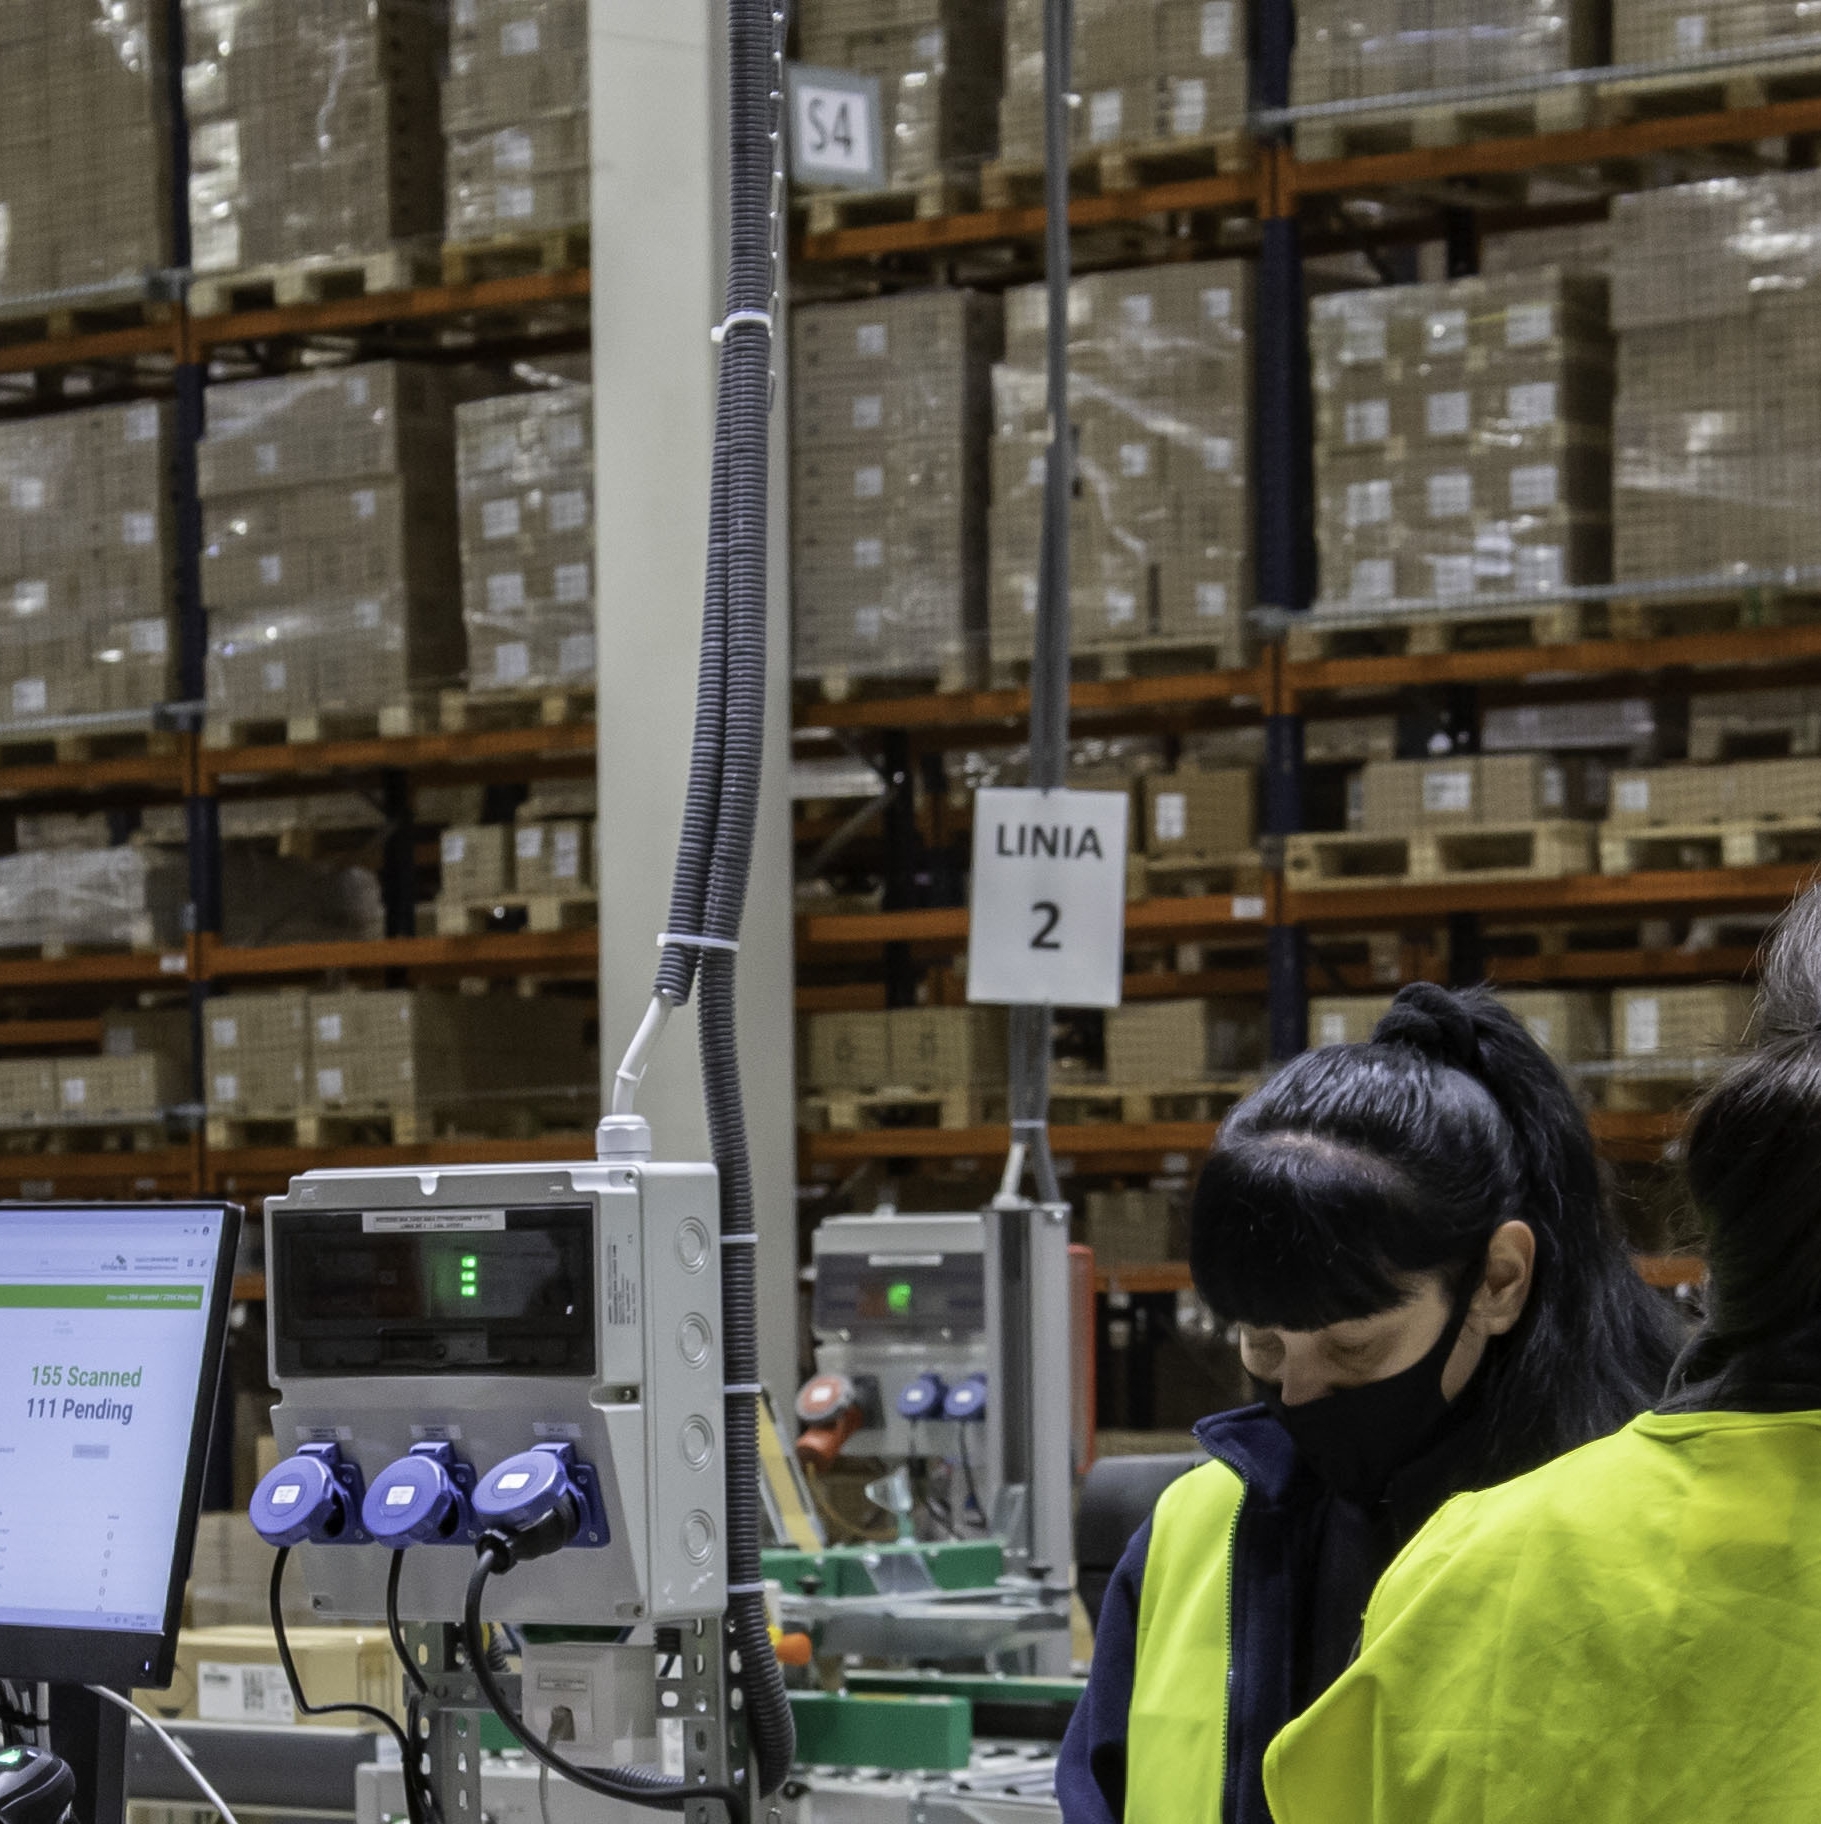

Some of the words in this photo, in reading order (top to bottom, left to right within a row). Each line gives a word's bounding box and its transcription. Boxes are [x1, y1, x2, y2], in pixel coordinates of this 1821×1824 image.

[807, 97, 853, 156] S4
[996, 824, 1103, 860] LINIA
[1030, 902, 1062, 949] 2
[32, 1365, 62, 1386] 155
[67, 1365, 143, 1388] Scanned
[27, 1398, 56, 1418] 111
[62, 1398, 133, 1425] Pending
